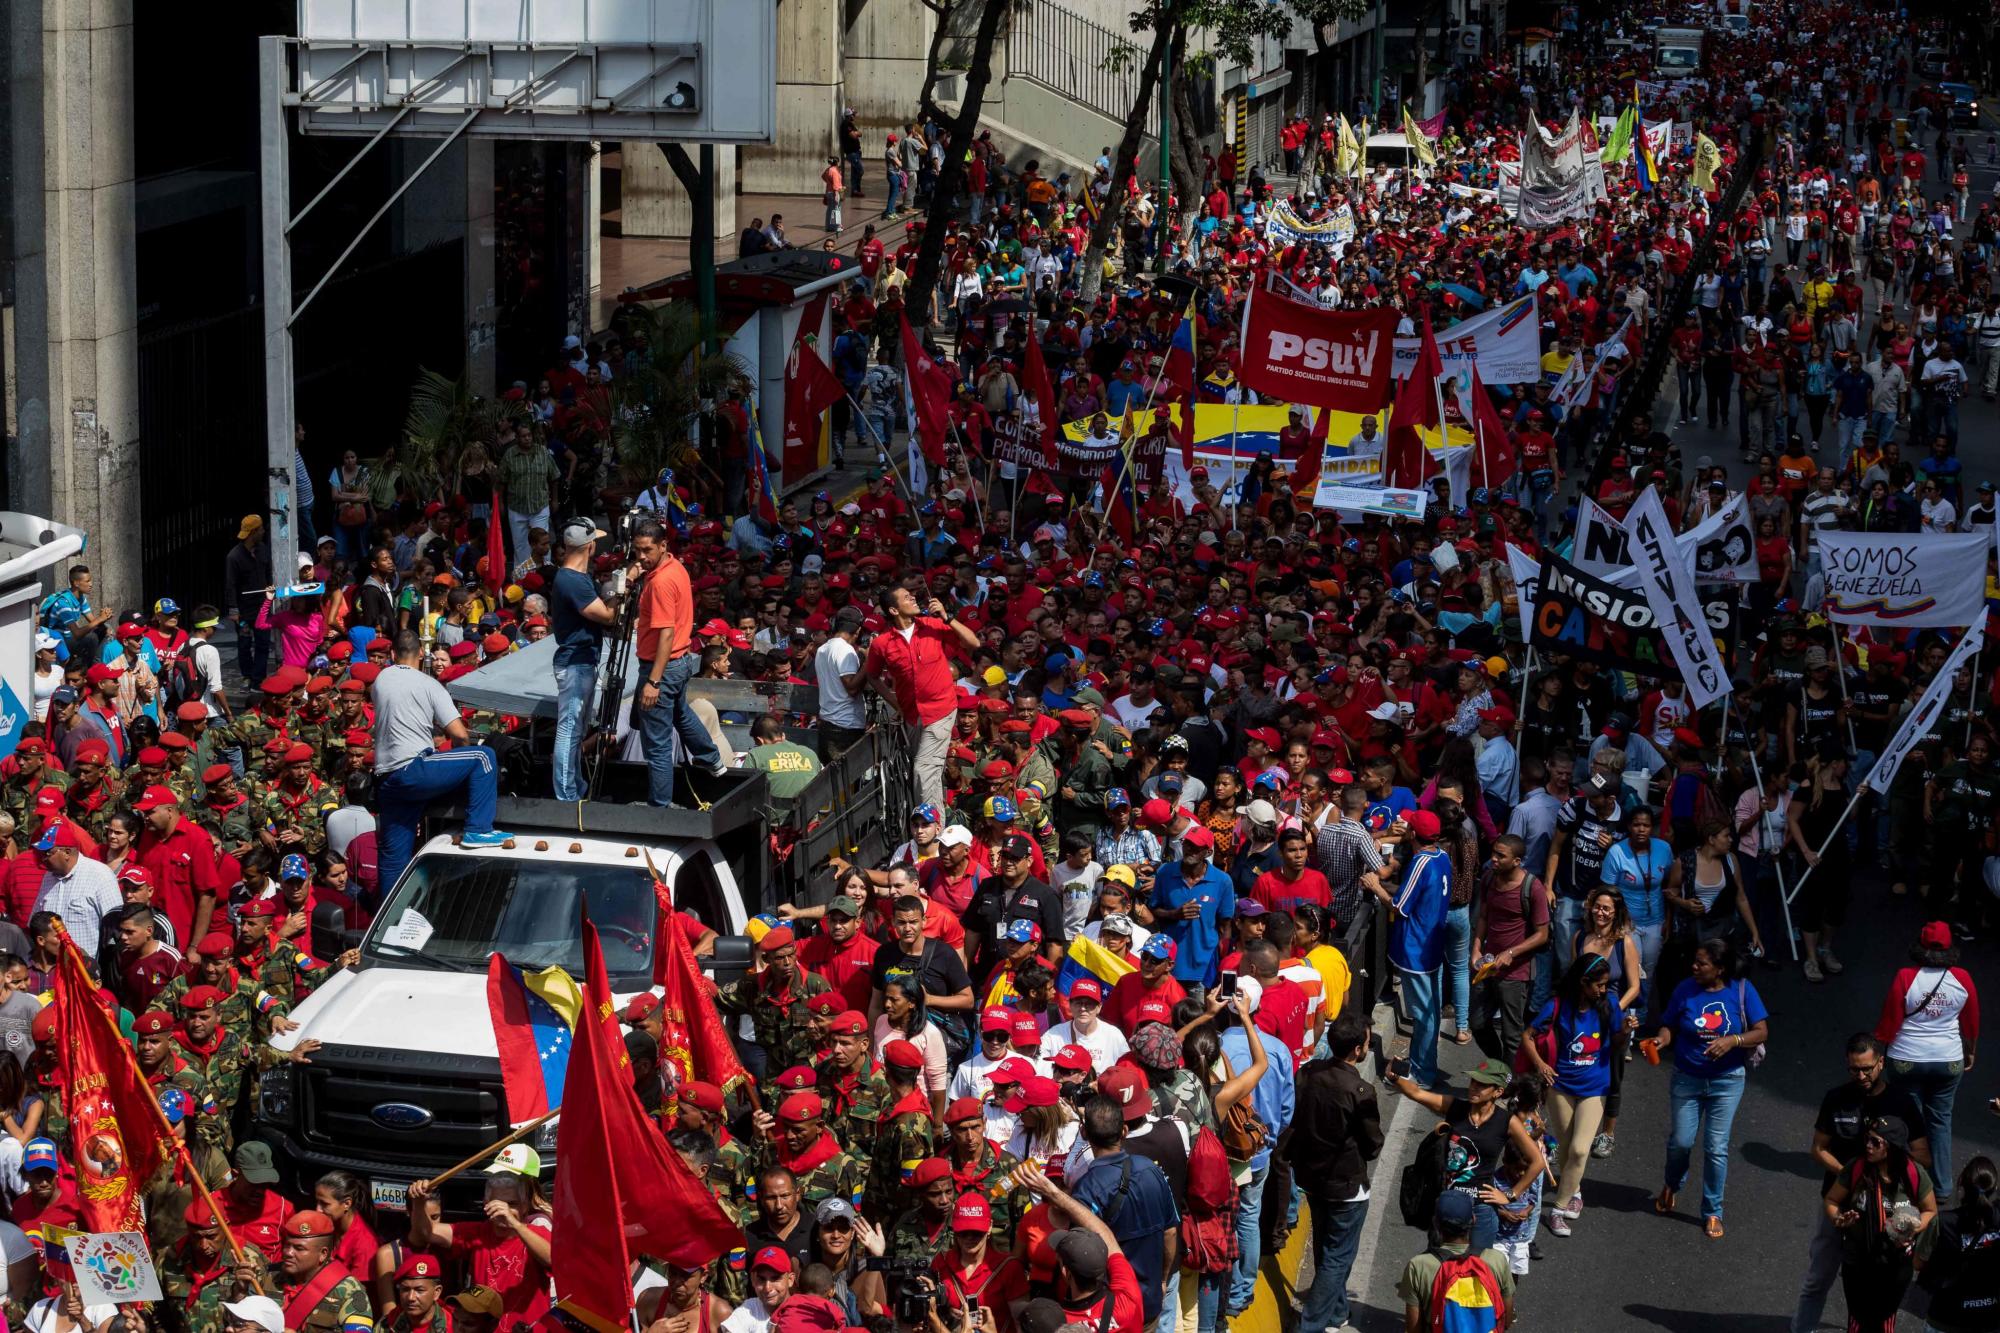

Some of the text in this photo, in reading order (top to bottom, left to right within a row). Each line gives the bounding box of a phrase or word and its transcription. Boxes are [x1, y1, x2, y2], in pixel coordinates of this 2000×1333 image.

[1268, 329, 1379, 377] PSUV
[1266, 364, 1369, 389] PARTIDO SOCIALISTA UNIDO DE VENEZUELA
[1827, 546, 1918, 577] SOMOS
[1547, 565, 1730, 631] MISIOS
[1825, 574, 1922, 597] VENEZUELA
[769, 757, 812, 771] ERIKA
[329, 1050, 406, 1064] SUPER
[118, 1233, 151, 1264] PARAISO
